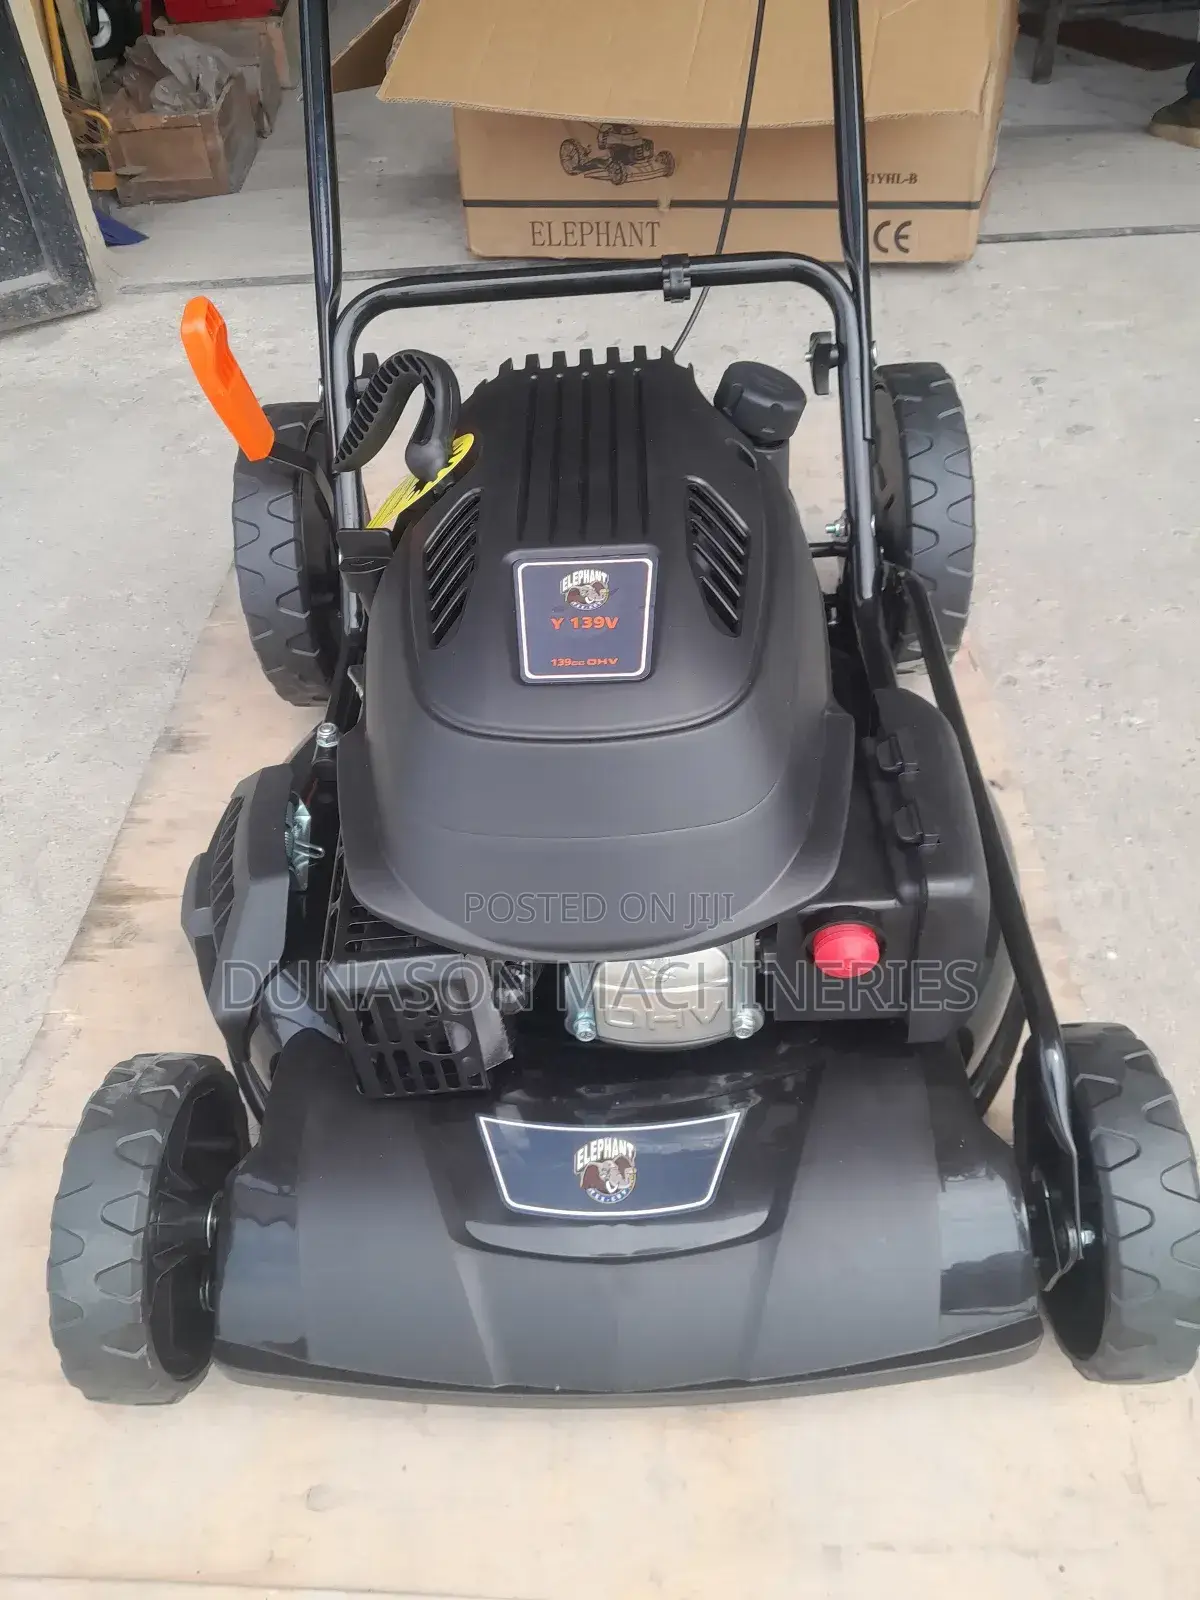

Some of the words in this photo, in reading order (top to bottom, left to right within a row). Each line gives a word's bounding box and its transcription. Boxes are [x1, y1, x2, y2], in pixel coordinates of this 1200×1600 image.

[529, 221, 660, 247] ELEPHANT
[873, 220, 912, 253] CE
[562, 569, 608, 592] ELEPHANT
[550, 617, 565, 630] Y
[570, 616, 619, 630] 139V
[586, 657, 619, 667] OHV
[576, 1136, 635, 1172] ELEPHANT
